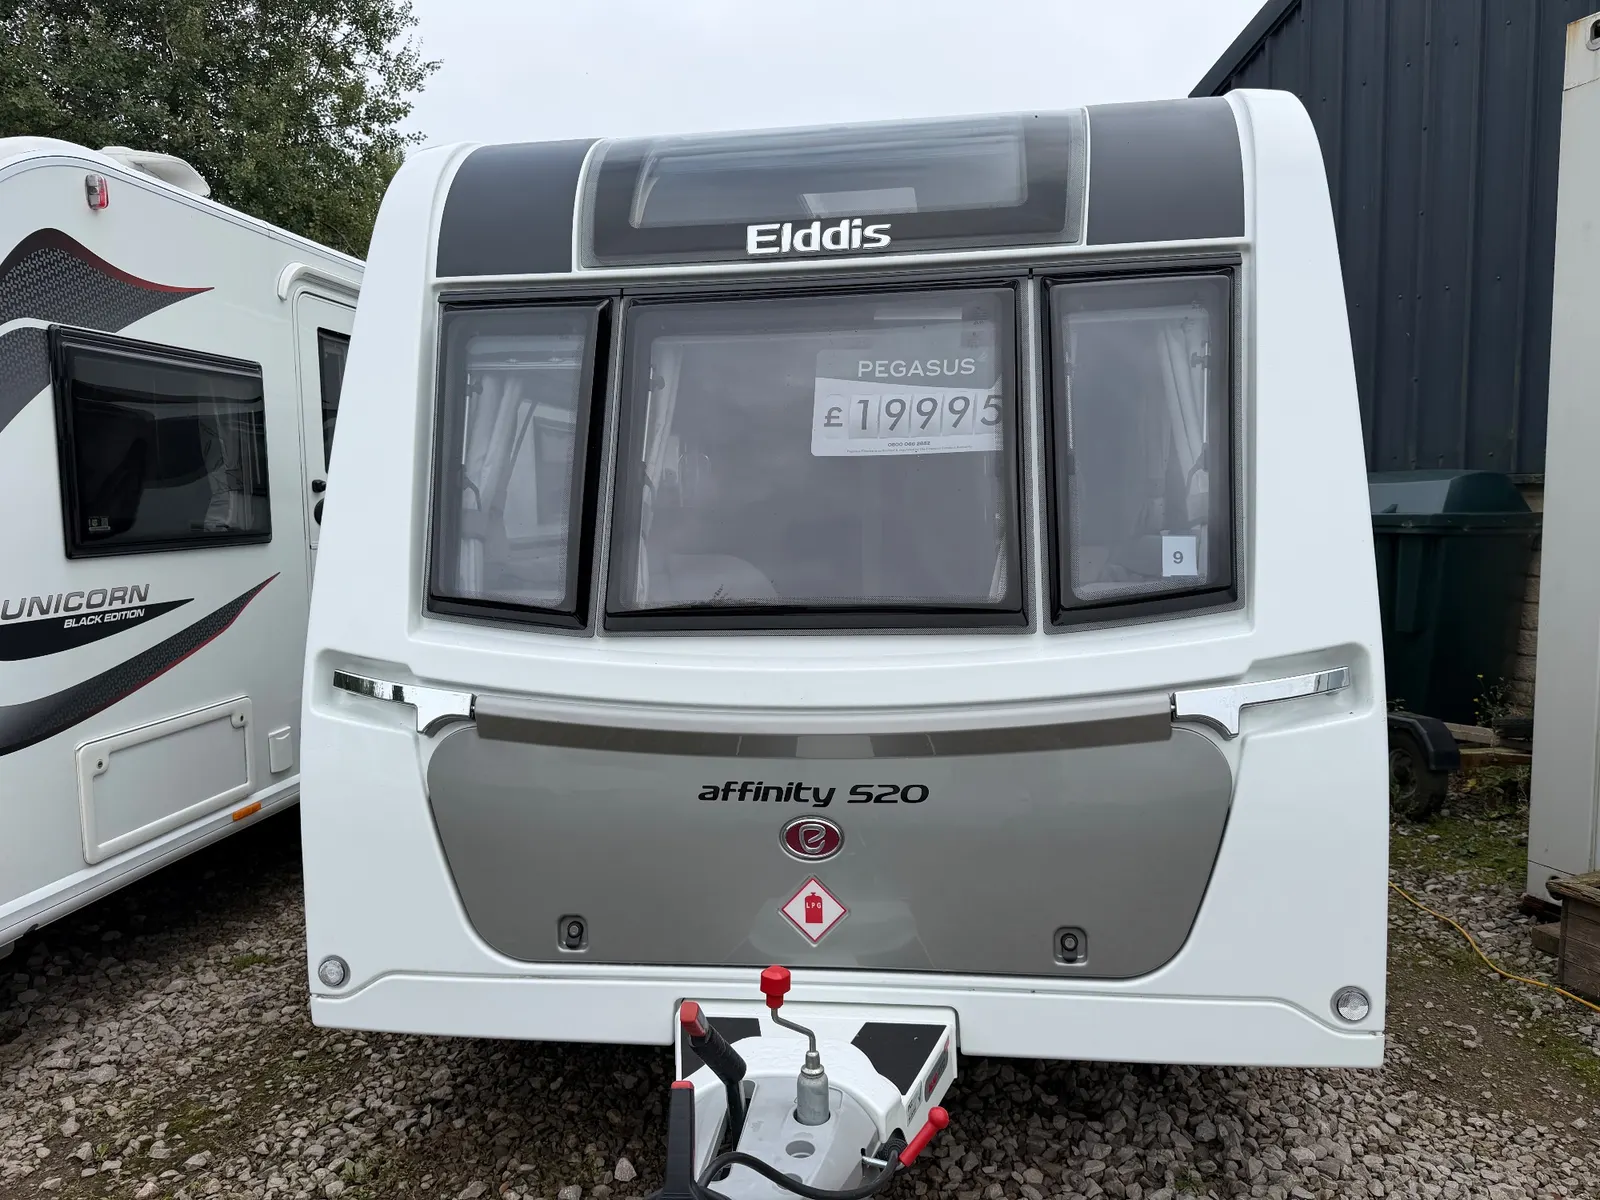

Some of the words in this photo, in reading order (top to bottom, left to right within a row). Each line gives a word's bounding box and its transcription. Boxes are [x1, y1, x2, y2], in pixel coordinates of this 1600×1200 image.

[746, 218, 892, 256] Elddis
[857, 358, 976, 377] PEGASUS
[1173, 550, 1184, 565] 9
[0, 584, 150, 620] UNICORN
[64, 615, 103, 629] BLACK
[104, 608, 145, 621] EDITION
[698, 781, 836, 808] affinity
